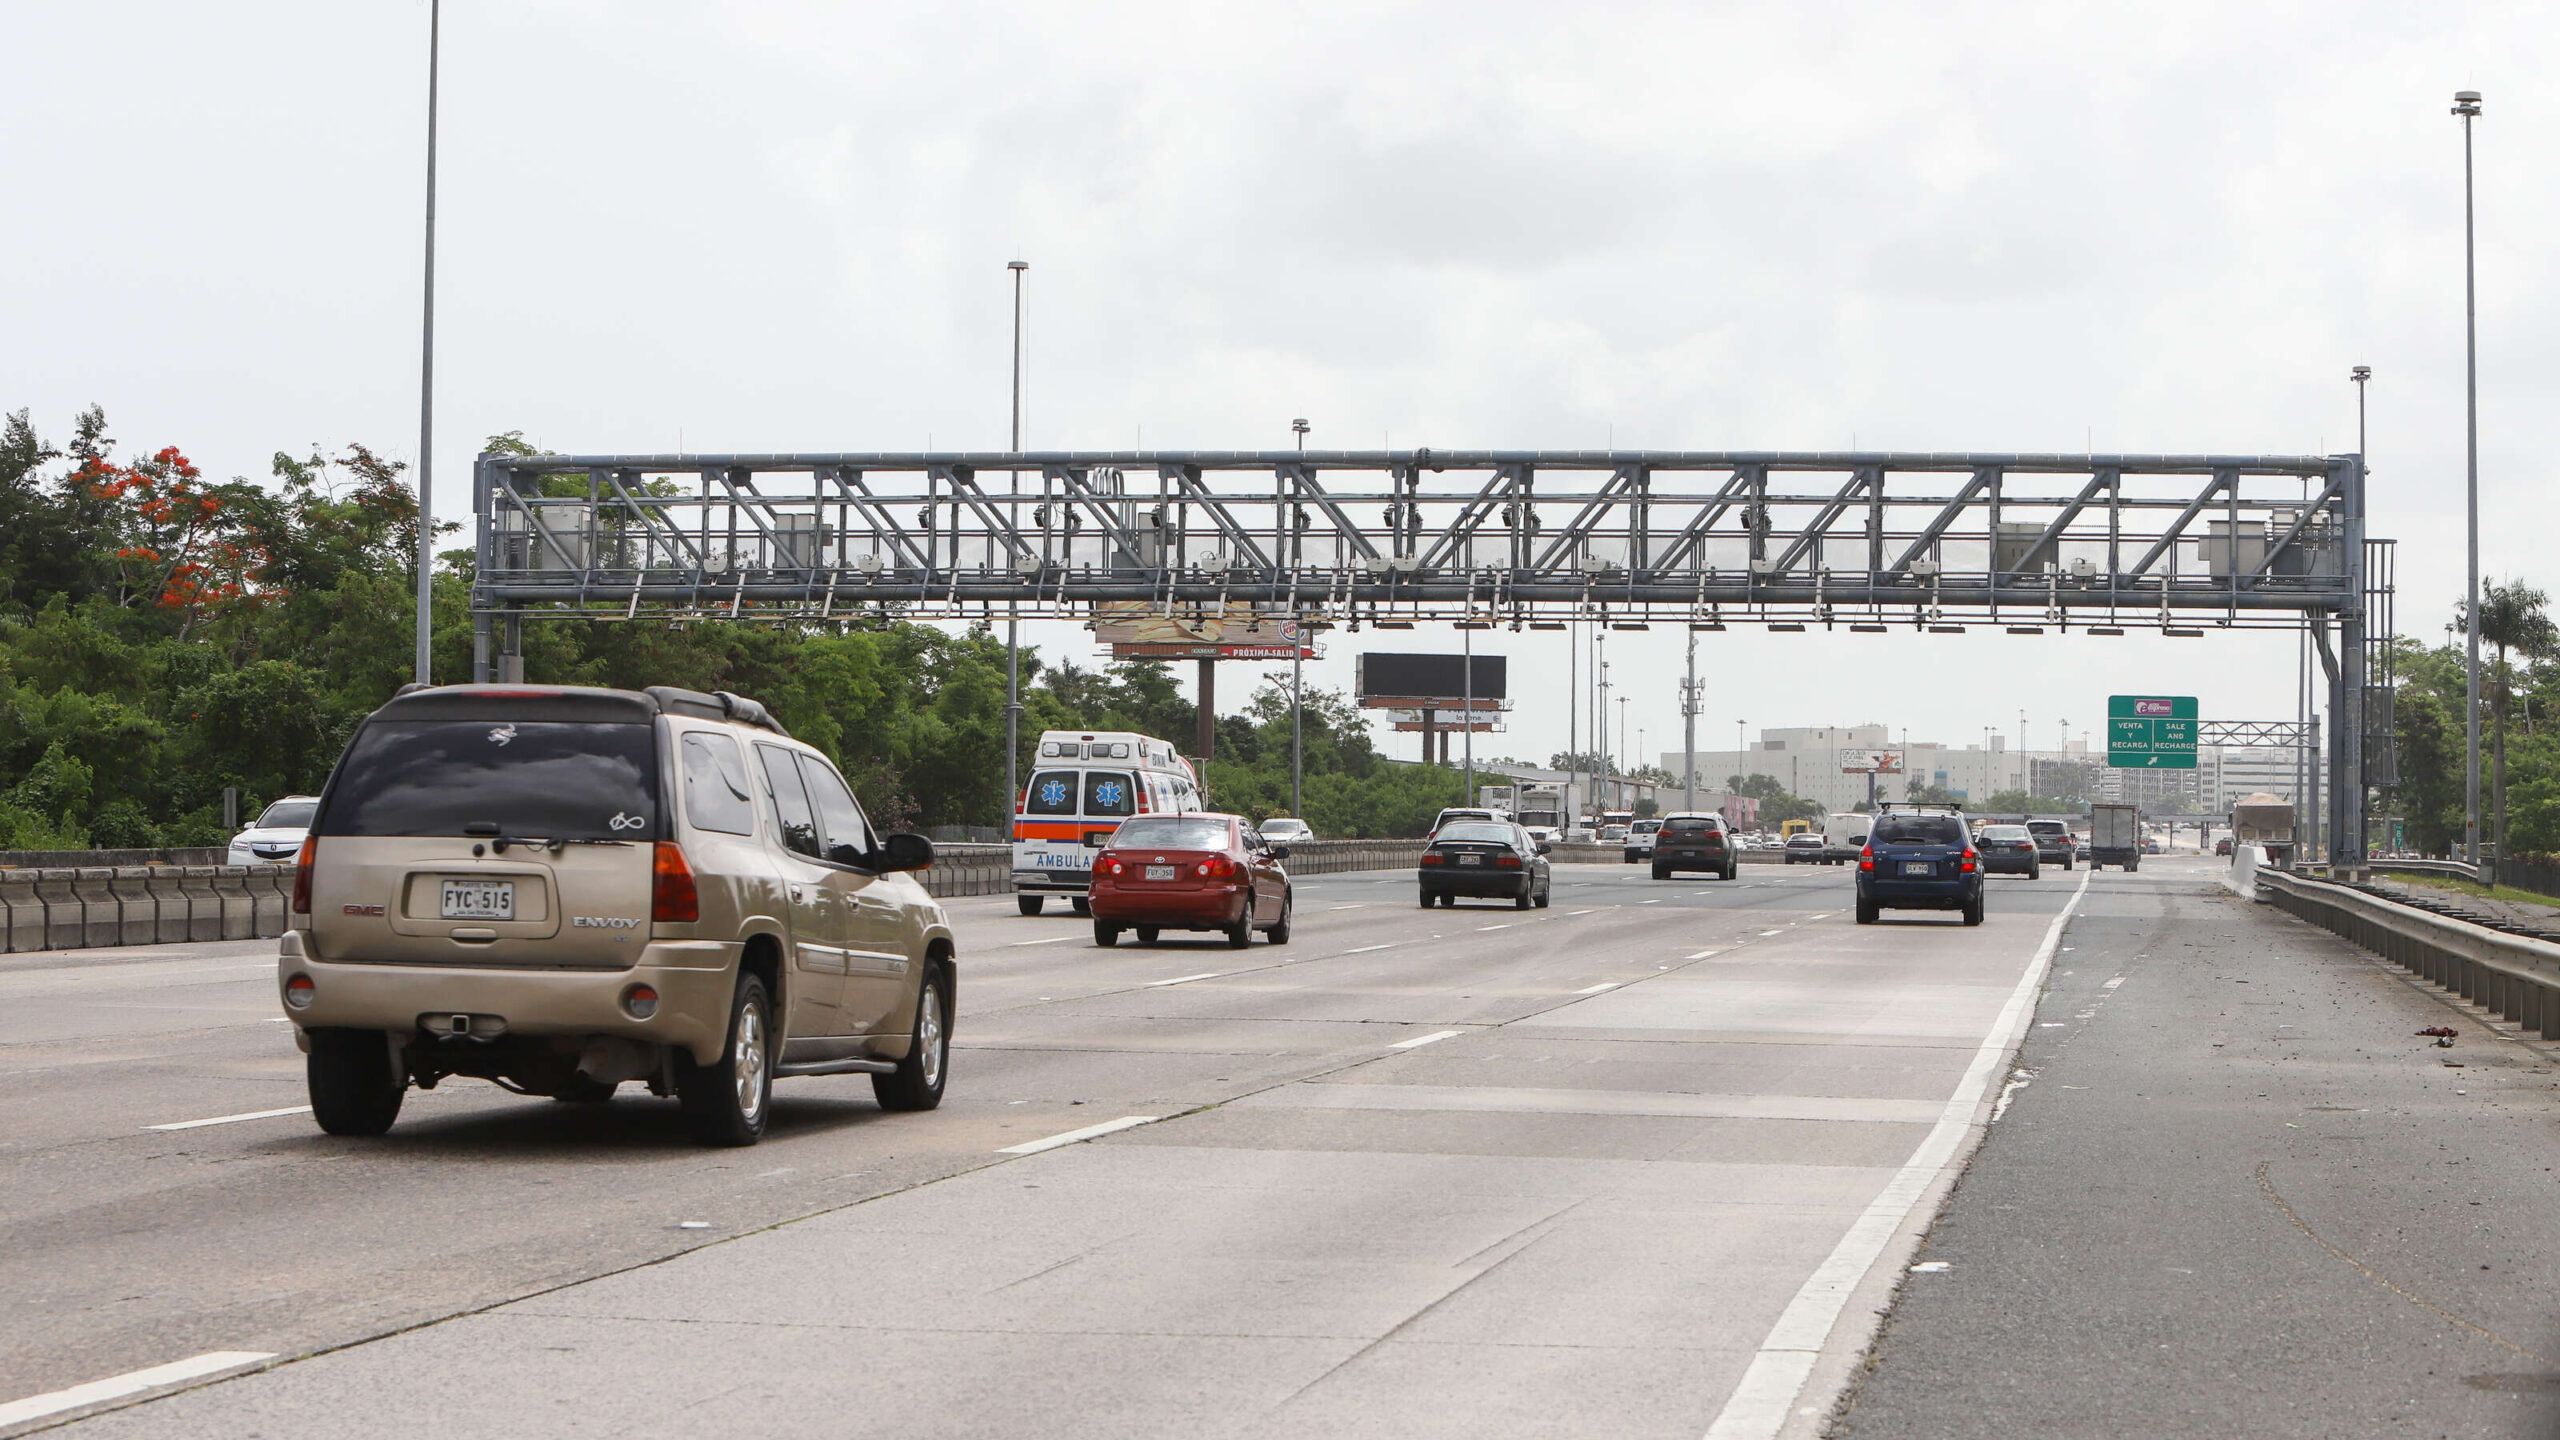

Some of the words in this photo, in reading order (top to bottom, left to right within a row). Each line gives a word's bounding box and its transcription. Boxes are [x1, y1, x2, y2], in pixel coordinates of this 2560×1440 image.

[1272, 649, 1295, 657] SALID
[2112, 741, 2148, 749] RECARGA
[2154, 742, 2196, 750] RECHARGE
[445, 890, 472, 908] FYC
[482, 891, 509, 909] 515
[343, 903, 385, 917] GMC
[573, 916, 641, 929] ENVOY
